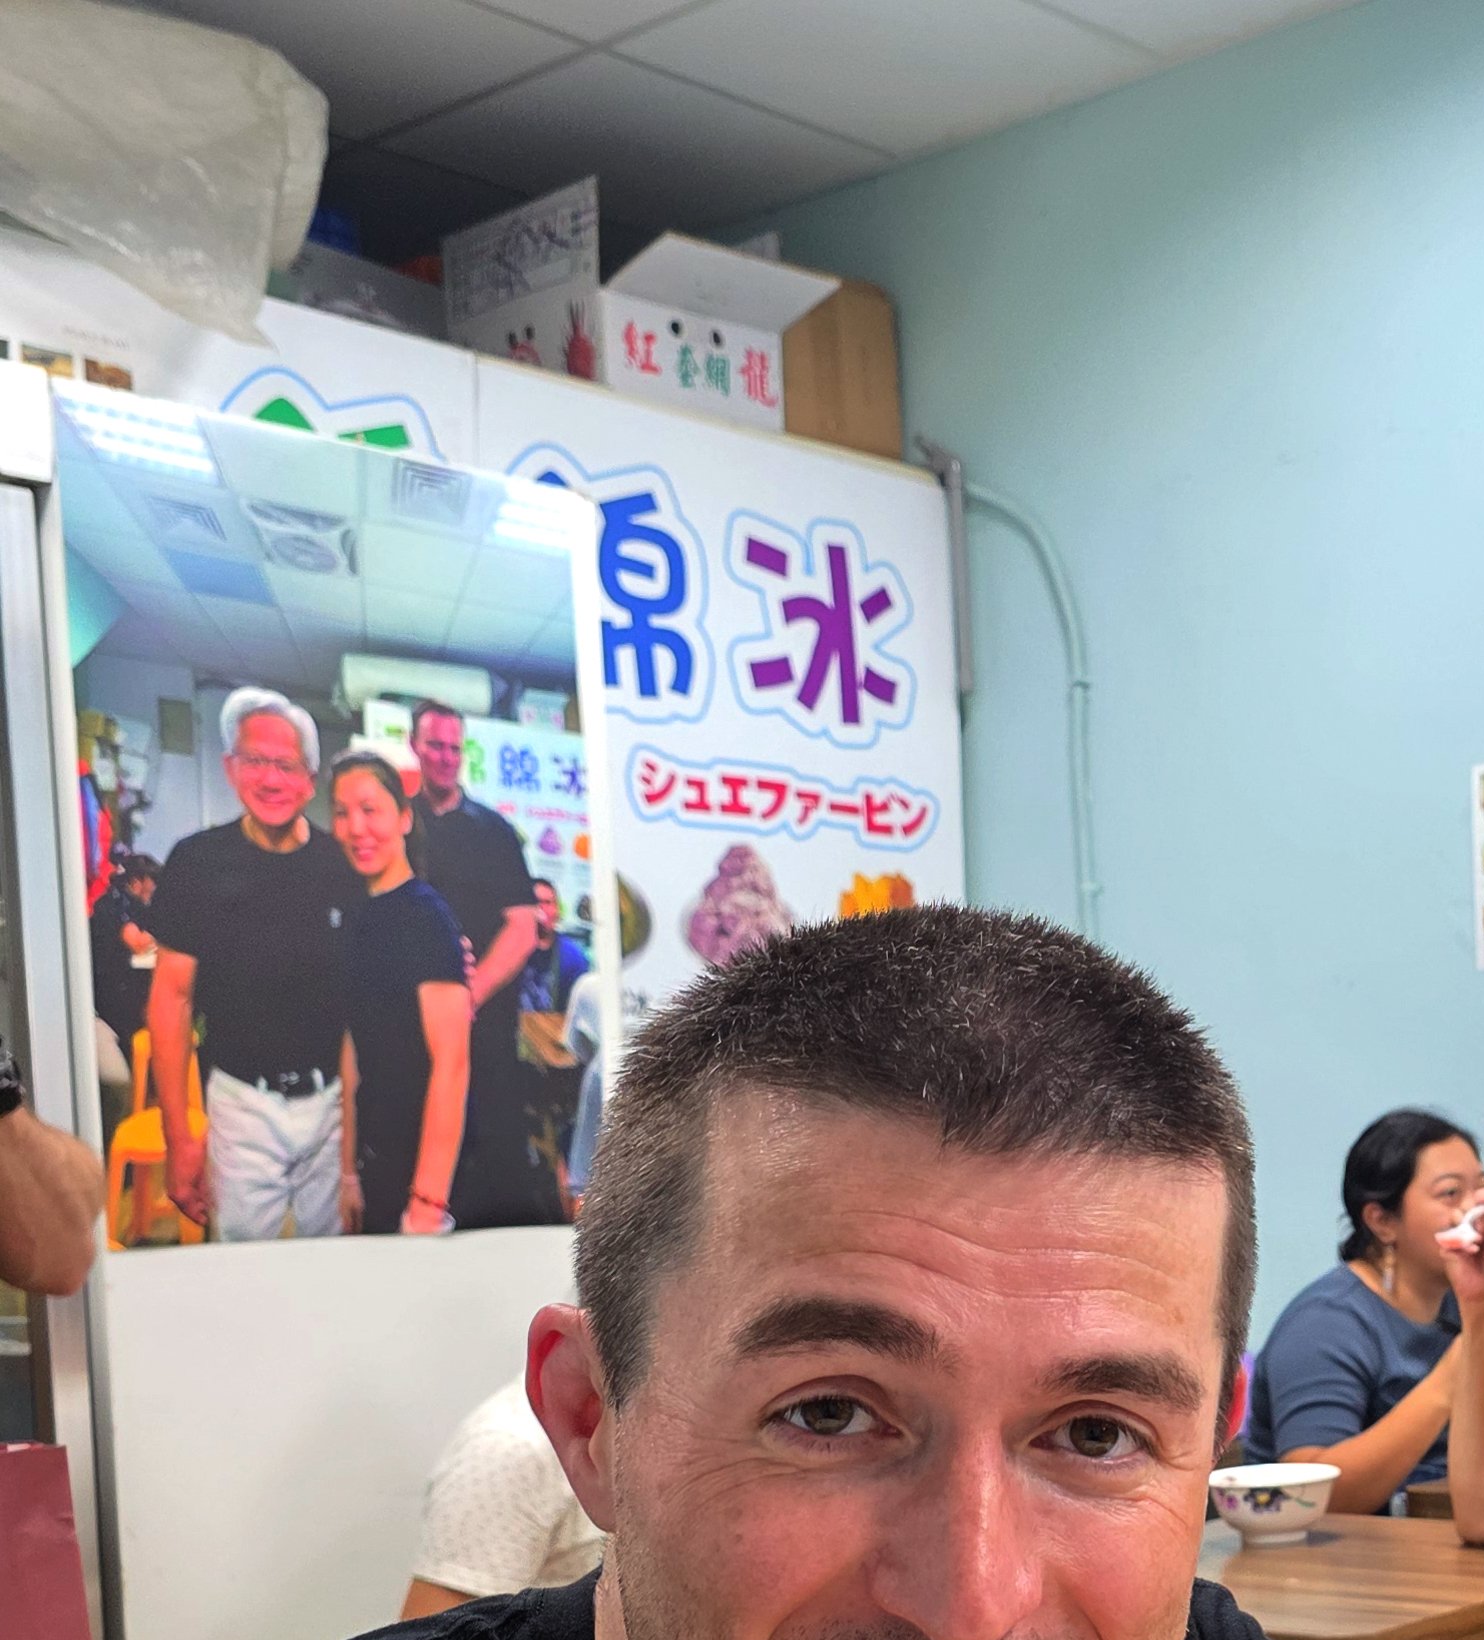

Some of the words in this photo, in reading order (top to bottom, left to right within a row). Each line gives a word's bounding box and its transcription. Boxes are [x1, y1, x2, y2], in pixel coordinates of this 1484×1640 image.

[638, 759, 928, 837] シュエファービン
